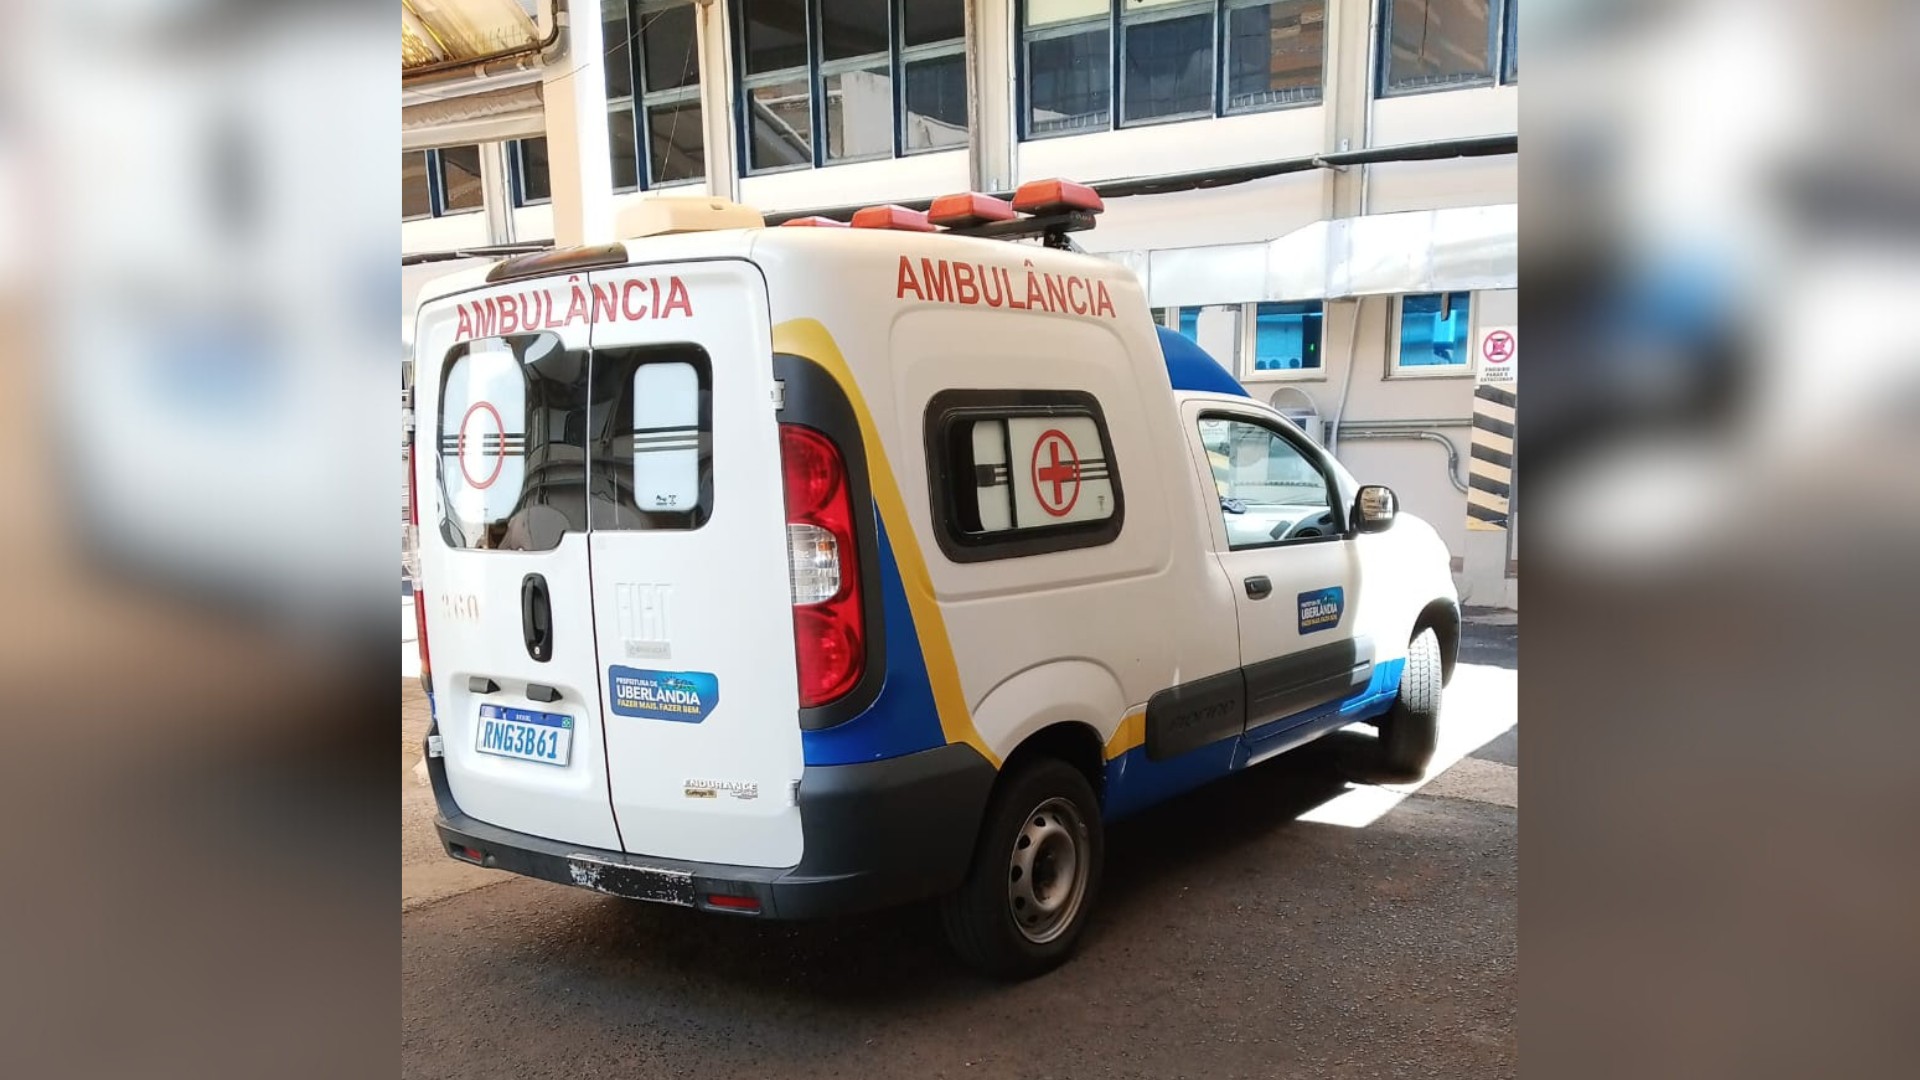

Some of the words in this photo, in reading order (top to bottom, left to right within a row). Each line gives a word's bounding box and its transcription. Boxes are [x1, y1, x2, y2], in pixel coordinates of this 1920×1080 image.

[455, 276, 693, 342] AMBULÂNCIA
[897, 256, 1116, 318] AMBULÂNCIA
[617, 699, 638, 708] FAZER
[660, 703, 682, 713] FAZER
[483, 720, 558, 759] RNG3B61
